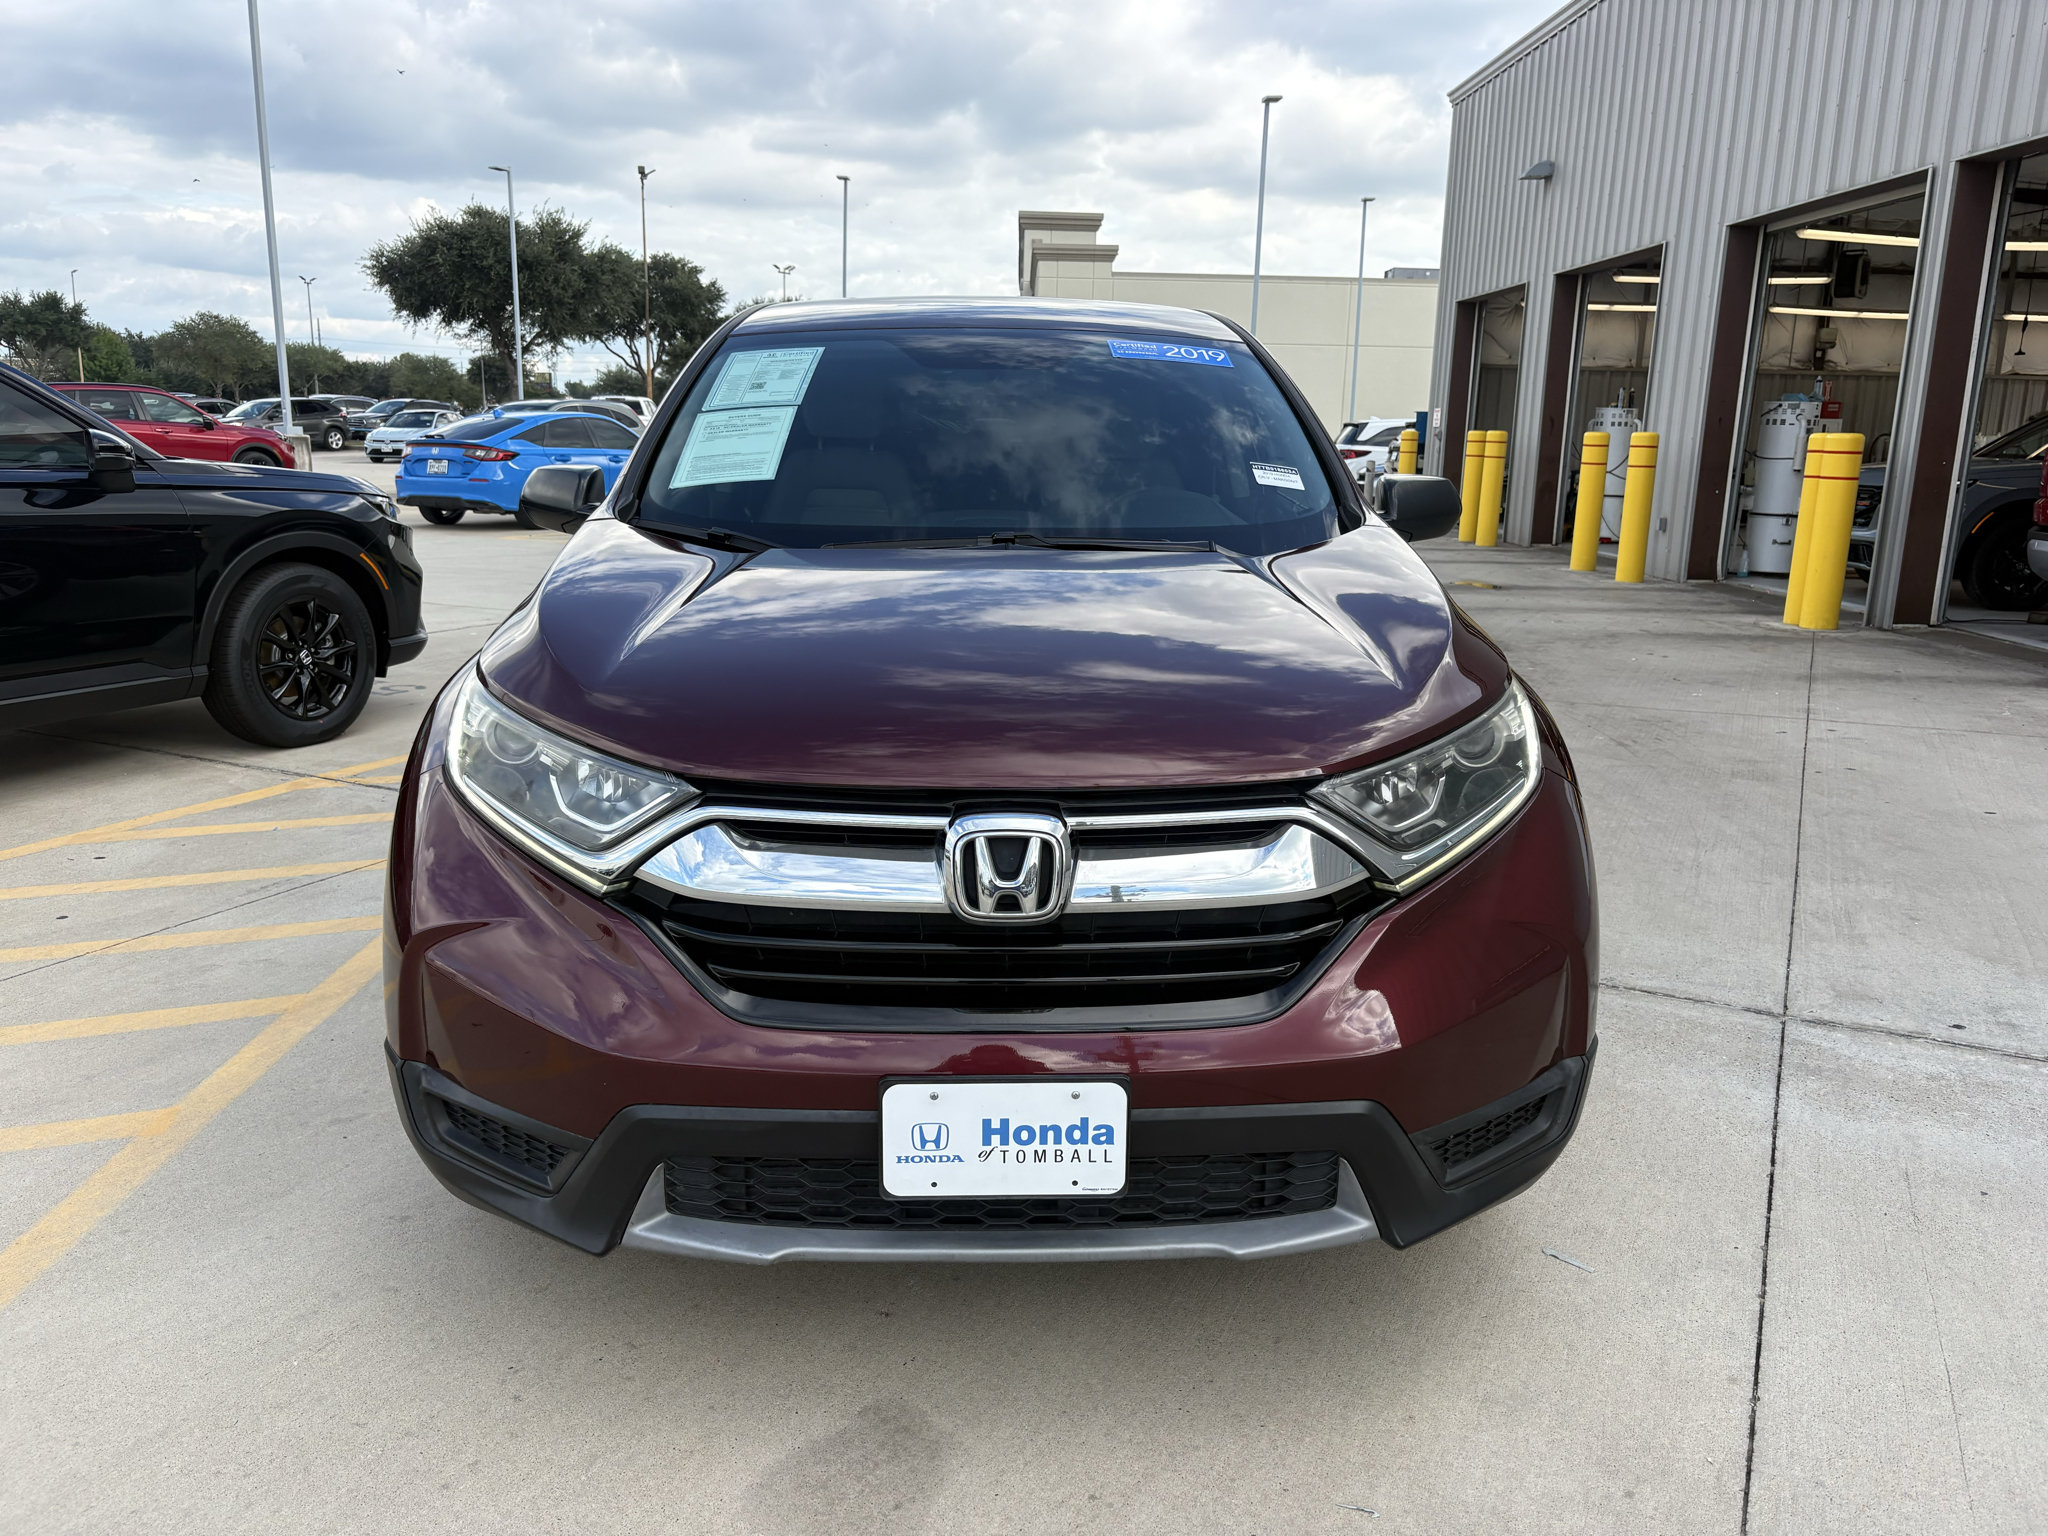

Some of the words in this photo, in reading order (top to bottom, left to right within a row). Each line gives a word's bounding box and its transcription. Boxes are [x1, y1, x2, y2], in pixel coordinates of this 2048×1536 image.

[1163, 345, 1225, 361] 2019
[981, 1117, 1115, 1146] Honda
[895, 1154, 965, 1163] HONDA
[977, 1146, 998, 1163] of
[1000, 1149, 1113, 1163] TOMBALL
